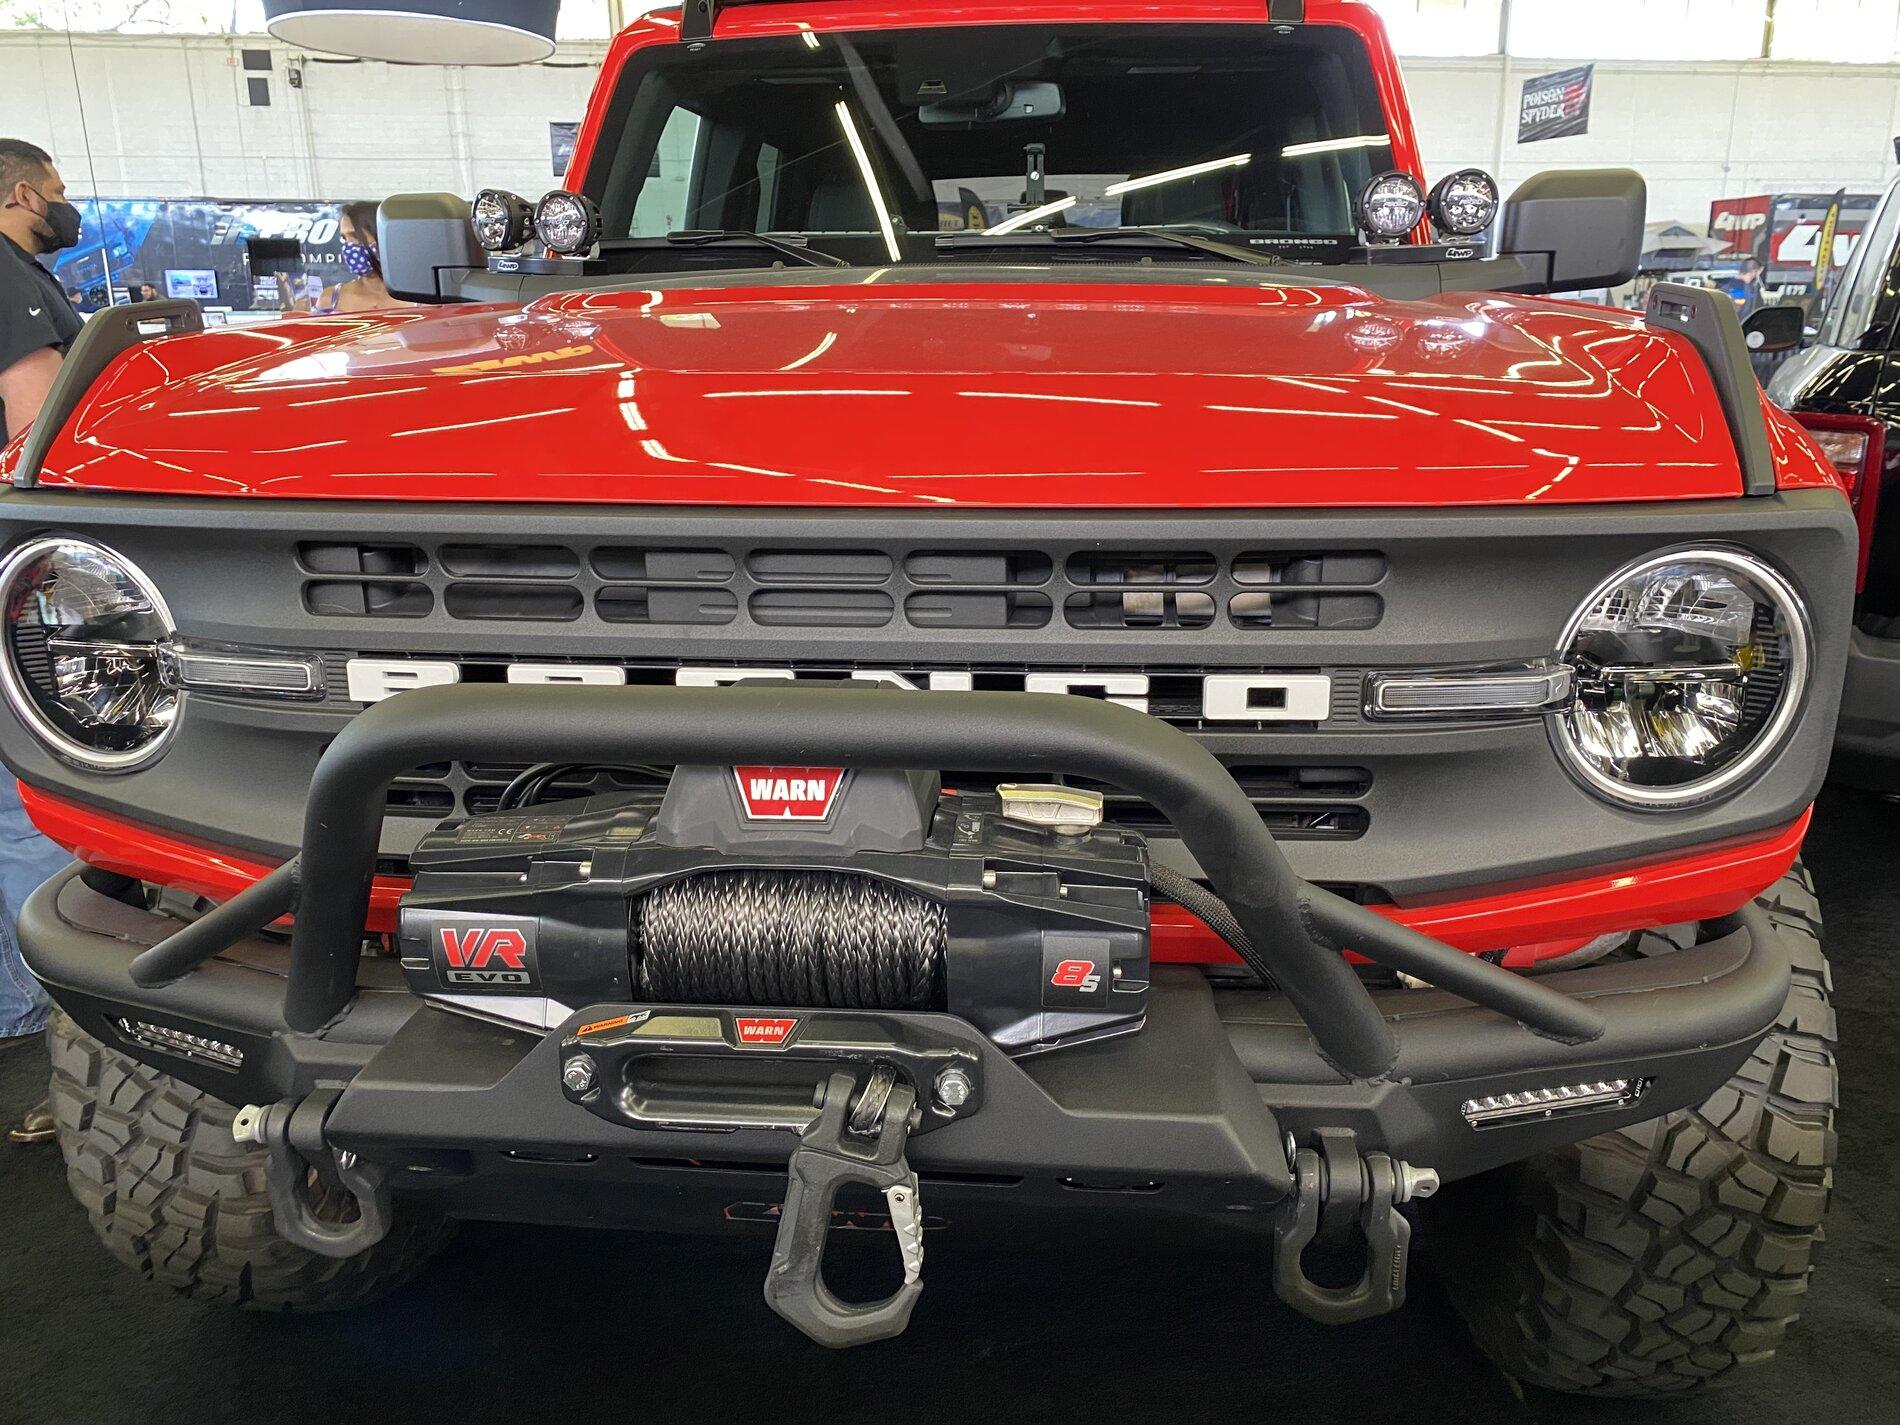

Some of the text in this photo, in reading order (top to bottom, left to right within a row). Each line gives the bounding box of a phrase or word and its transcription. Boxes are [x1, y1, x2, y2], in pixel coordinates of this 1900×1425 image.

[1524, 87, 1565, 109] POISON
[1521, 103, 1566, 124] SPYDER
[750, 778, 826, 801] WARN
[440, 928, 527, 969] VR
[454, 973, 523, 983] EVO
[743, 1025, 785, 1036] WARN
